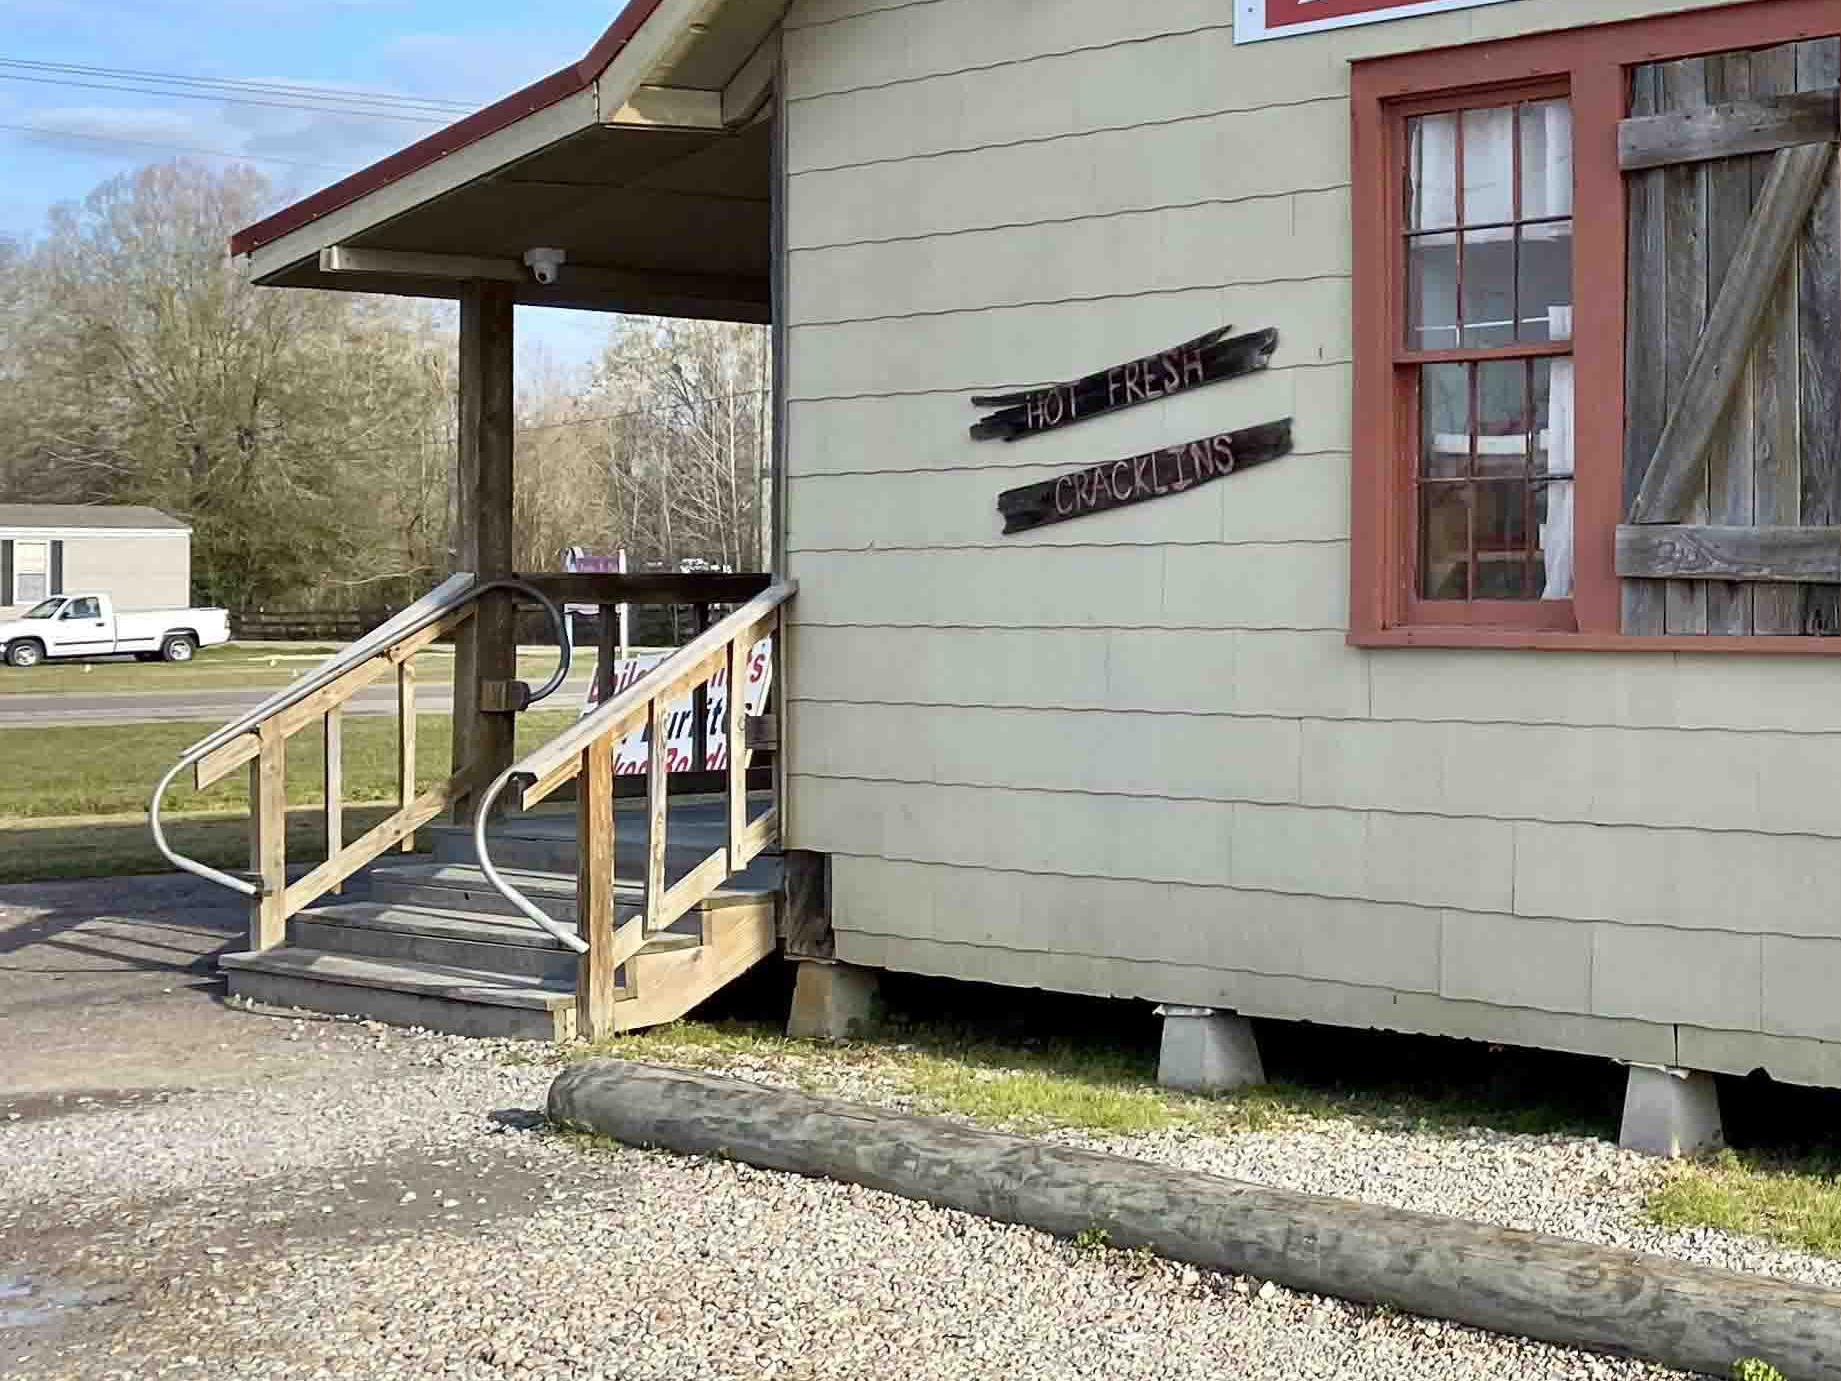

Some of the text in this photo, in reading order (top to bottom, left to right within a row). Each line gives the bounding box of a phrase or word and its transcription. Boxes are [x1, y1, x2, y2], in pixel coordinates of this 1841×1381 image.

[1025, 348, 1204, 429] HOT FRESH
[1055, 436, 1235, 515] CRACKLINS
